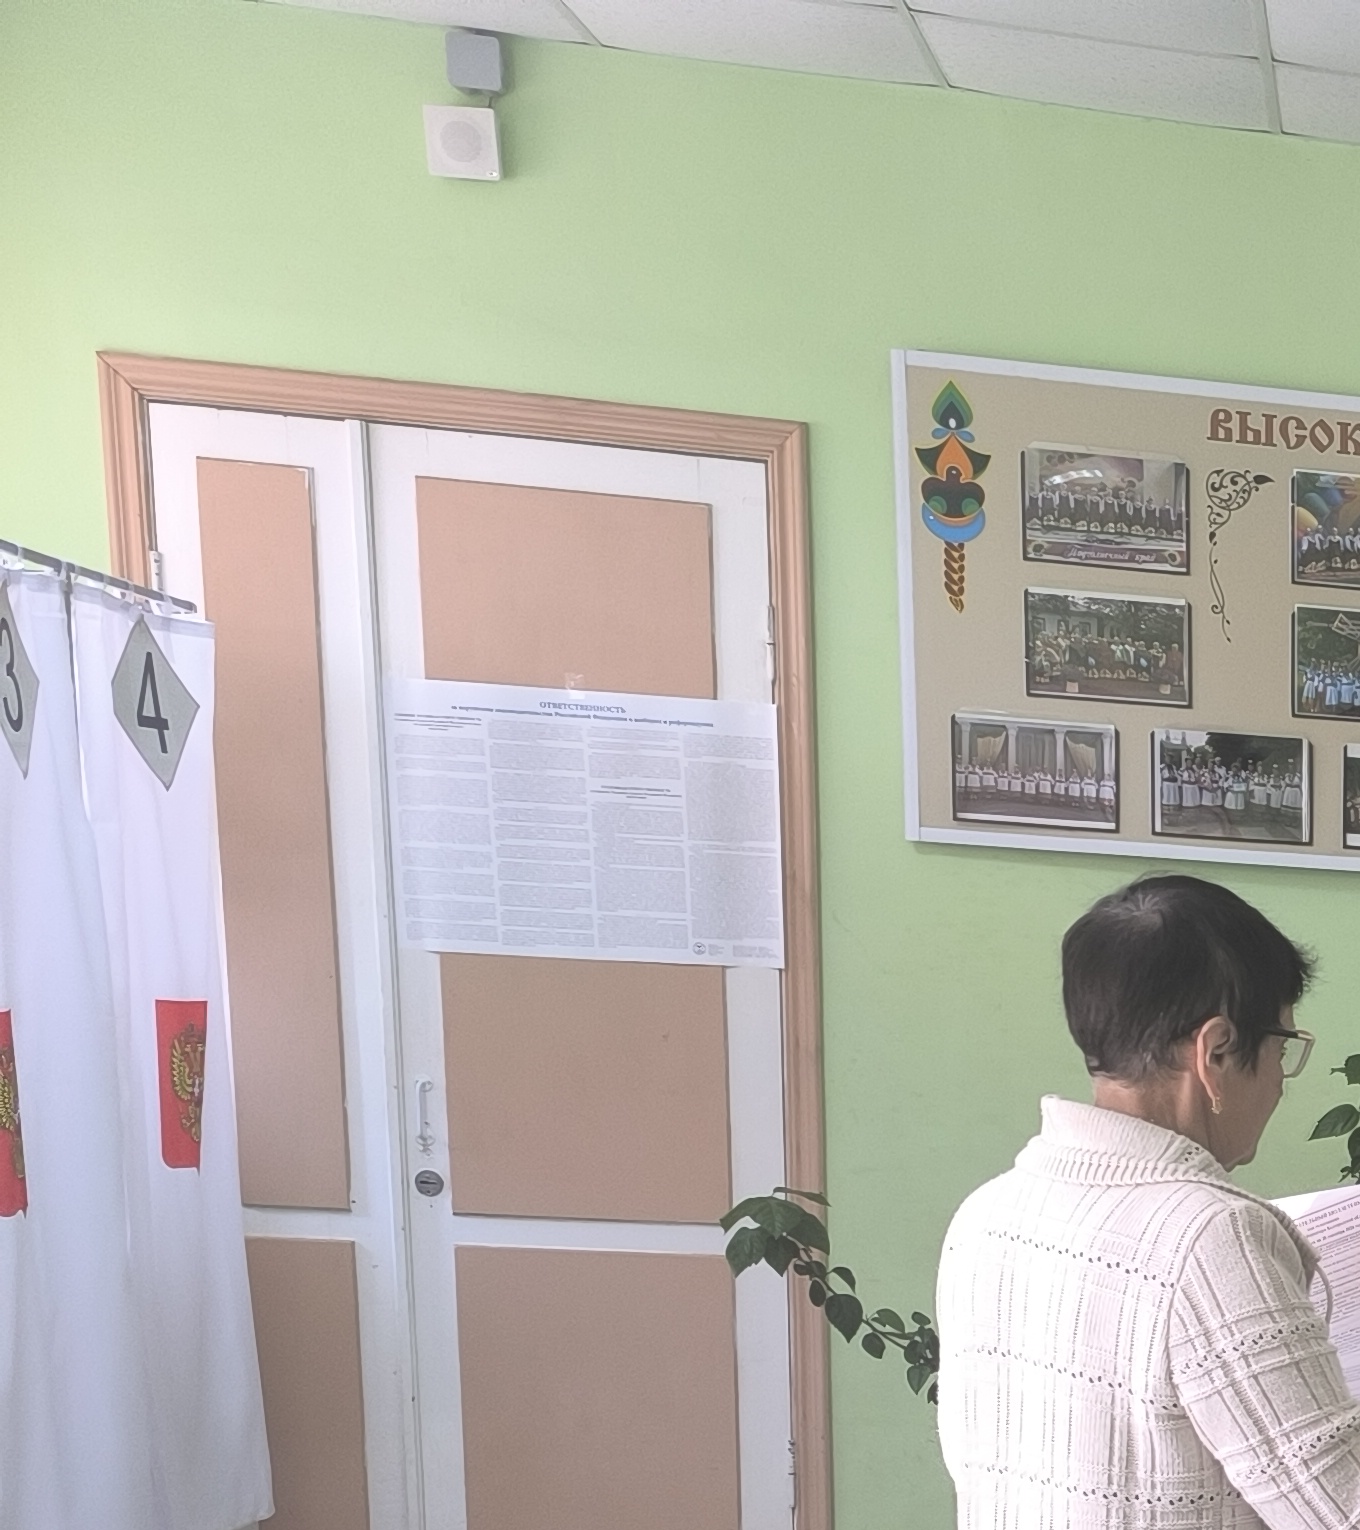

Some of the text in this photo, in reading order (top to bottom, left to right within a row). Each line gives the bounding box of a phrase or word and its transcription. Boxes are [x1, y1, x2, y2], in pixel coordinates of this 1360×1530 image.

[0, 617, 23, 733] 3
[137, 651, 169, 754] 4
[539, 701, 628, 715] ОТВЕТСТВЕННОСТЬ
